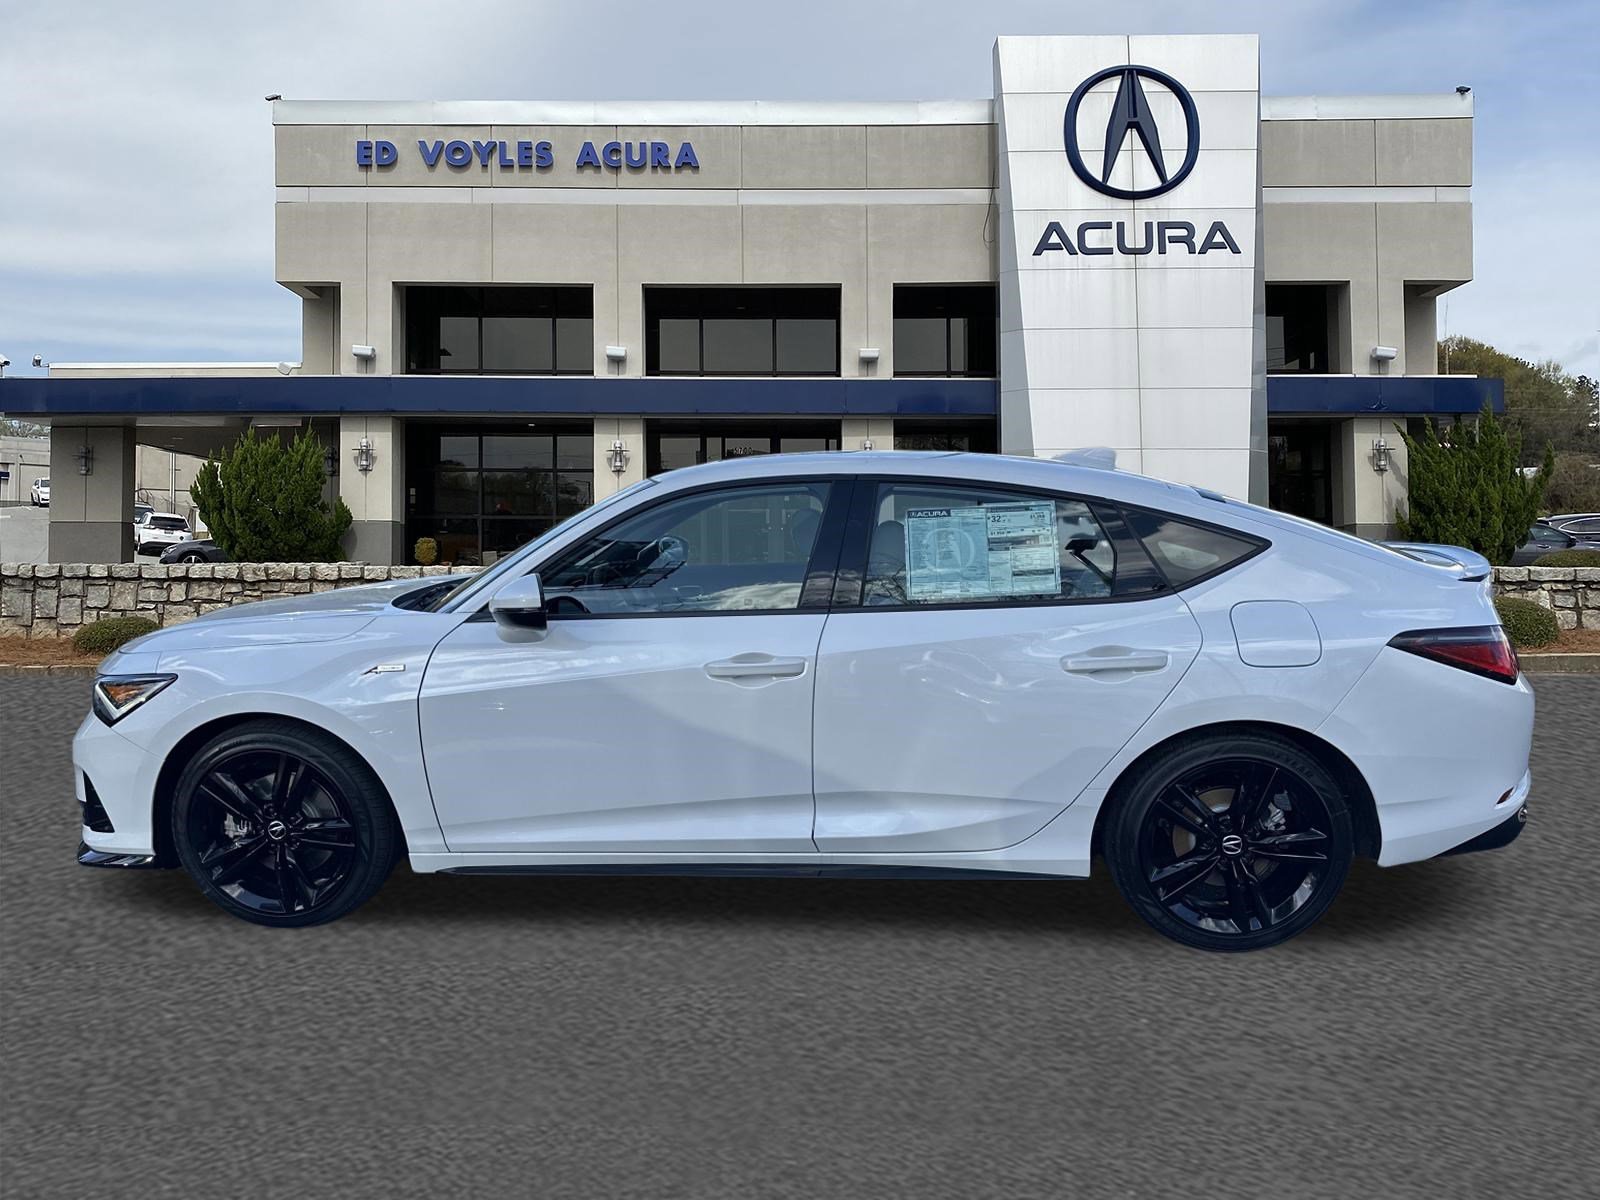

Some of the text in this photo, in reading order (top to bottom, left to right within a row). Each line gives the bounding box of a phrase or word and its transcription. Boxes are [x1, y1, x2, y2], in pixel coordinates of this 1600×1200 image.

[356, 141, 700, 168] ED VOYLES ACURA
[1032, 221, 1242, 256] ACURA
[991, 515, 1001, 523] 32
